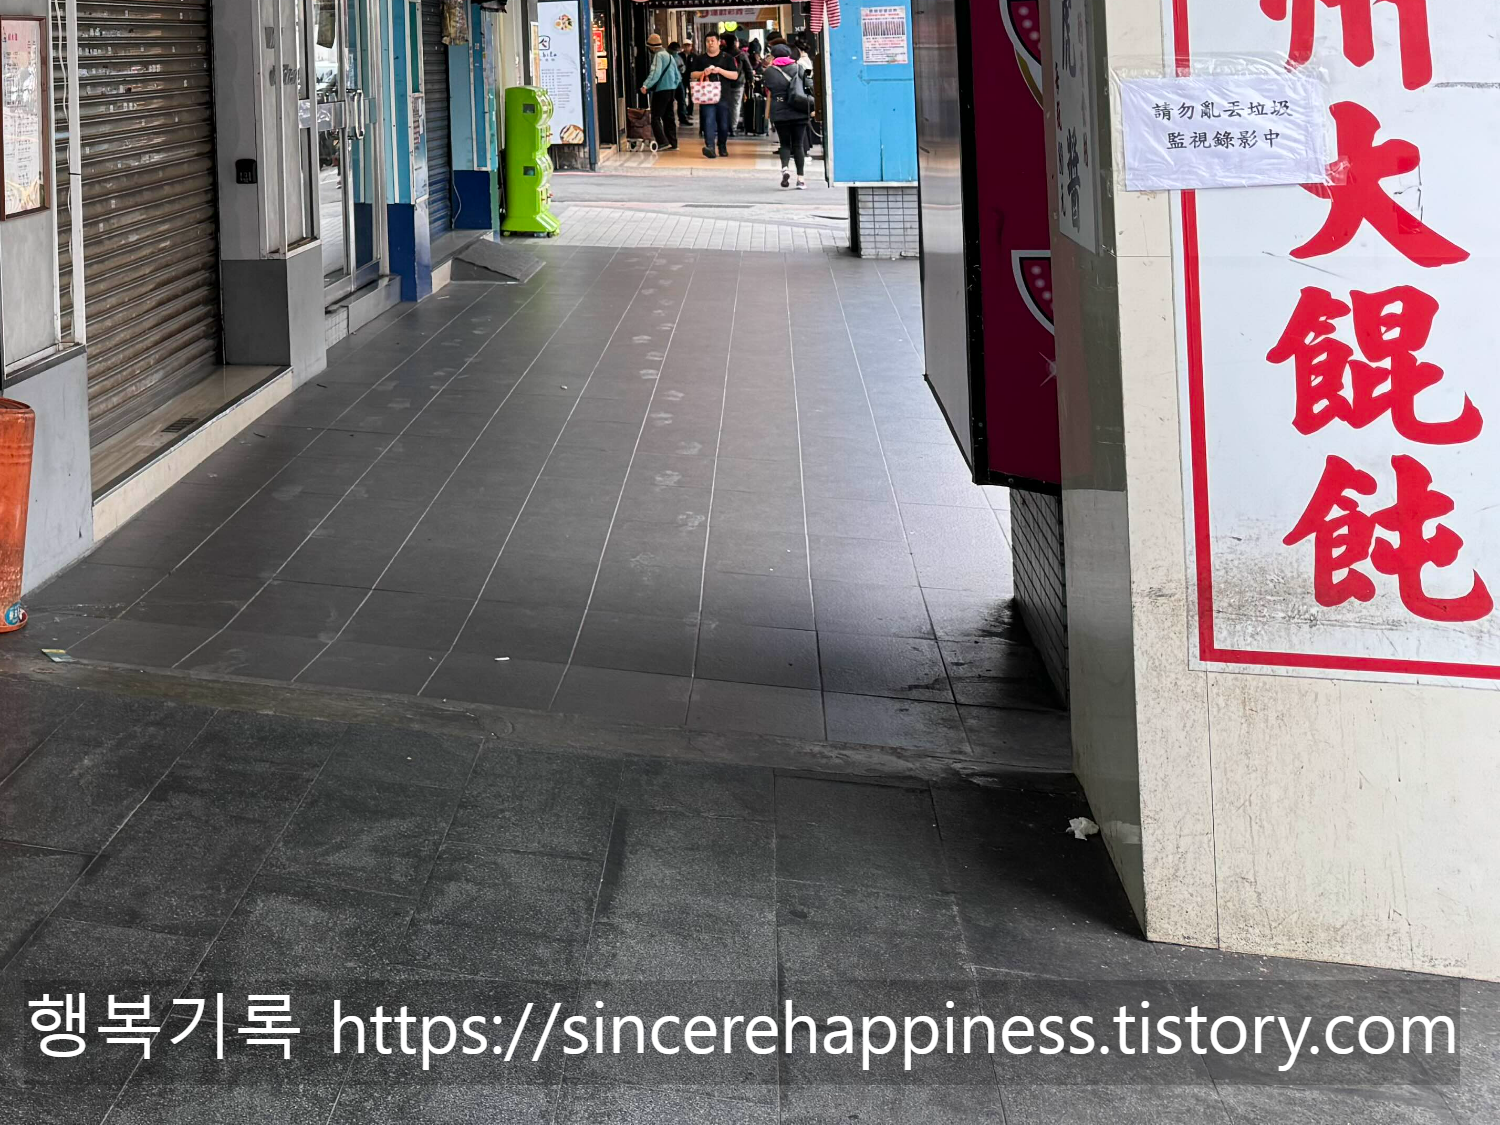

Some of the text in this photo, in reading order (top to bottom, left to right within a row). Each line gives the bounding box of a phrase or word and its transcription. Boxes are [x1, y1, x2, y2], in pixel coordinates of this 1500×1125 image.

[1152, 100, 1293, 120] 請勿亂丟垃圾
[1166, 129, 1281, 150] 監視錄影中
